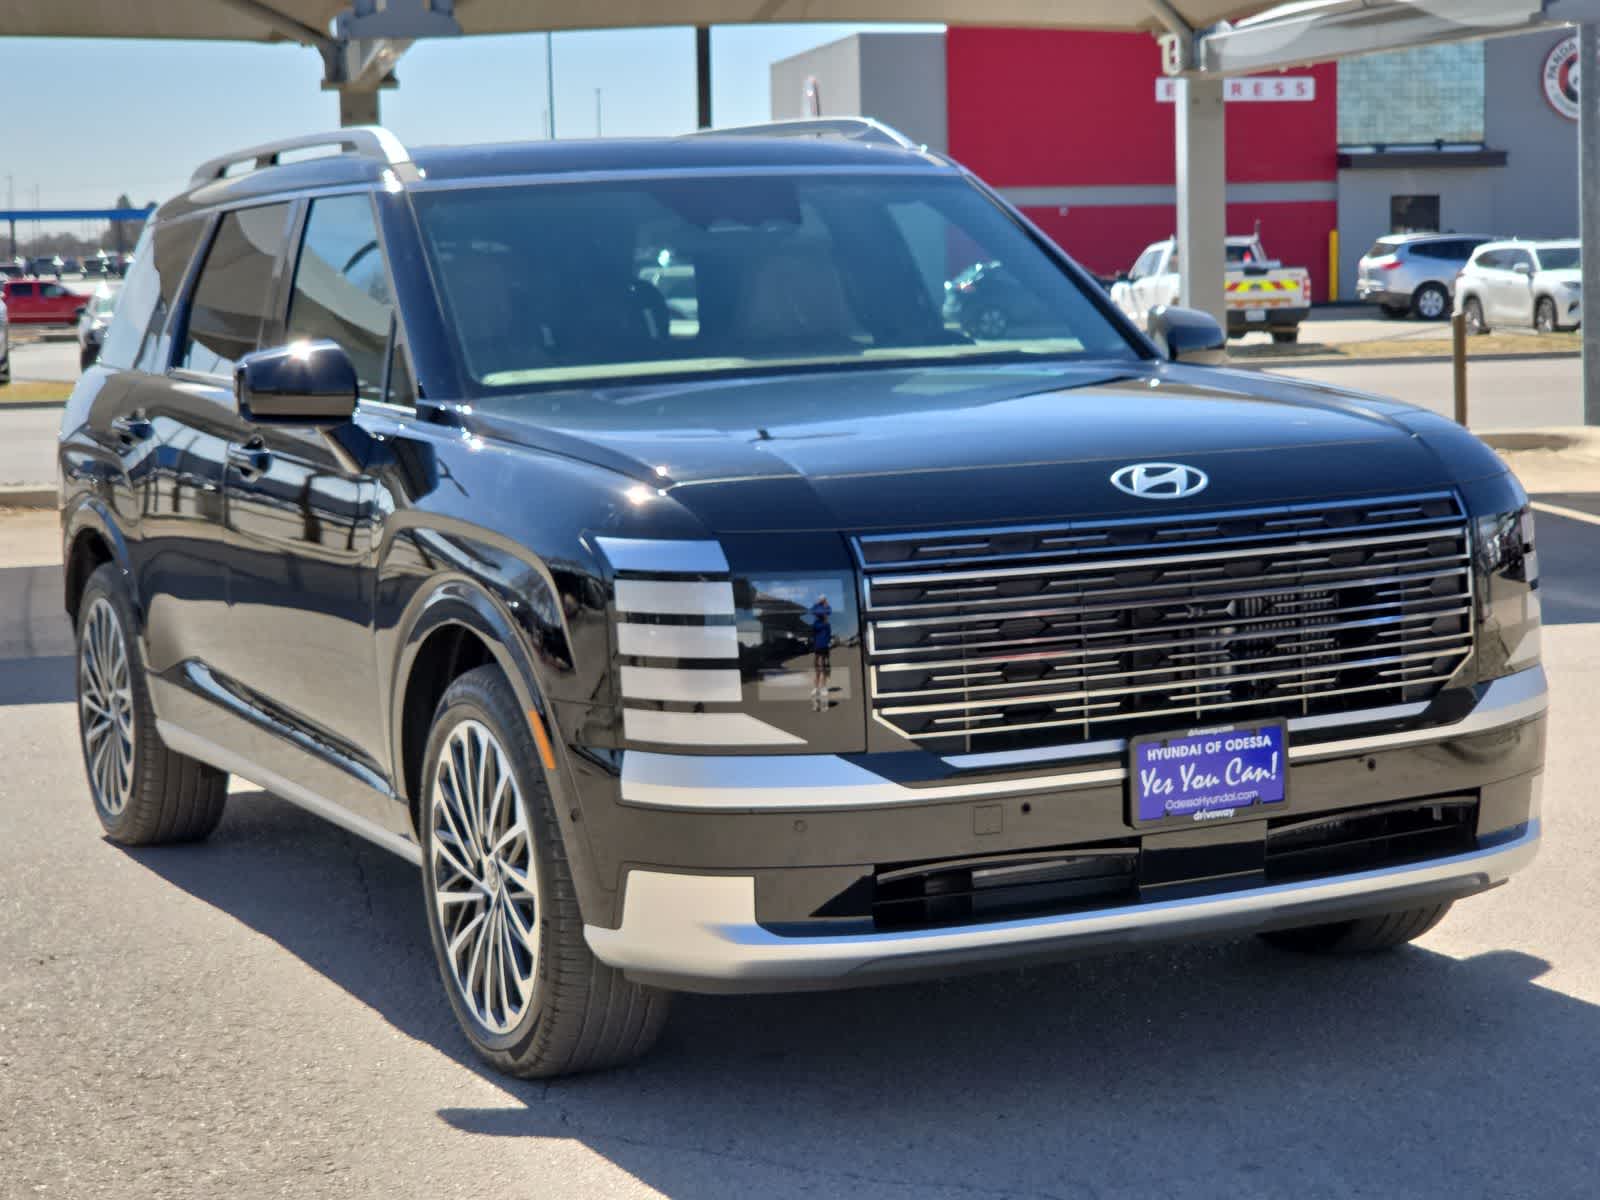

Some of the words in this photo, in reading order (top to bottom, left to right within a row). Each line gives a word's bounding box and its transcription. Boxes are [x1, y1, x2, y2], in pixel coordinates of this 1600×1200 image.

[1165, 82, 1306, 97] ERESS
[1147, 743, 1201, 761] HYUNDAI
[1205, 741, 1222, 754] OF
[1225, 735, 1272, 752] ODESSA
[1140, 767, 1175, 798] Yes
[1180, 762, 1220, 792] You
[1225, 751, 1279, 787] Can!
[1165, 791, 1258, 810] OdessaHyundai.com
